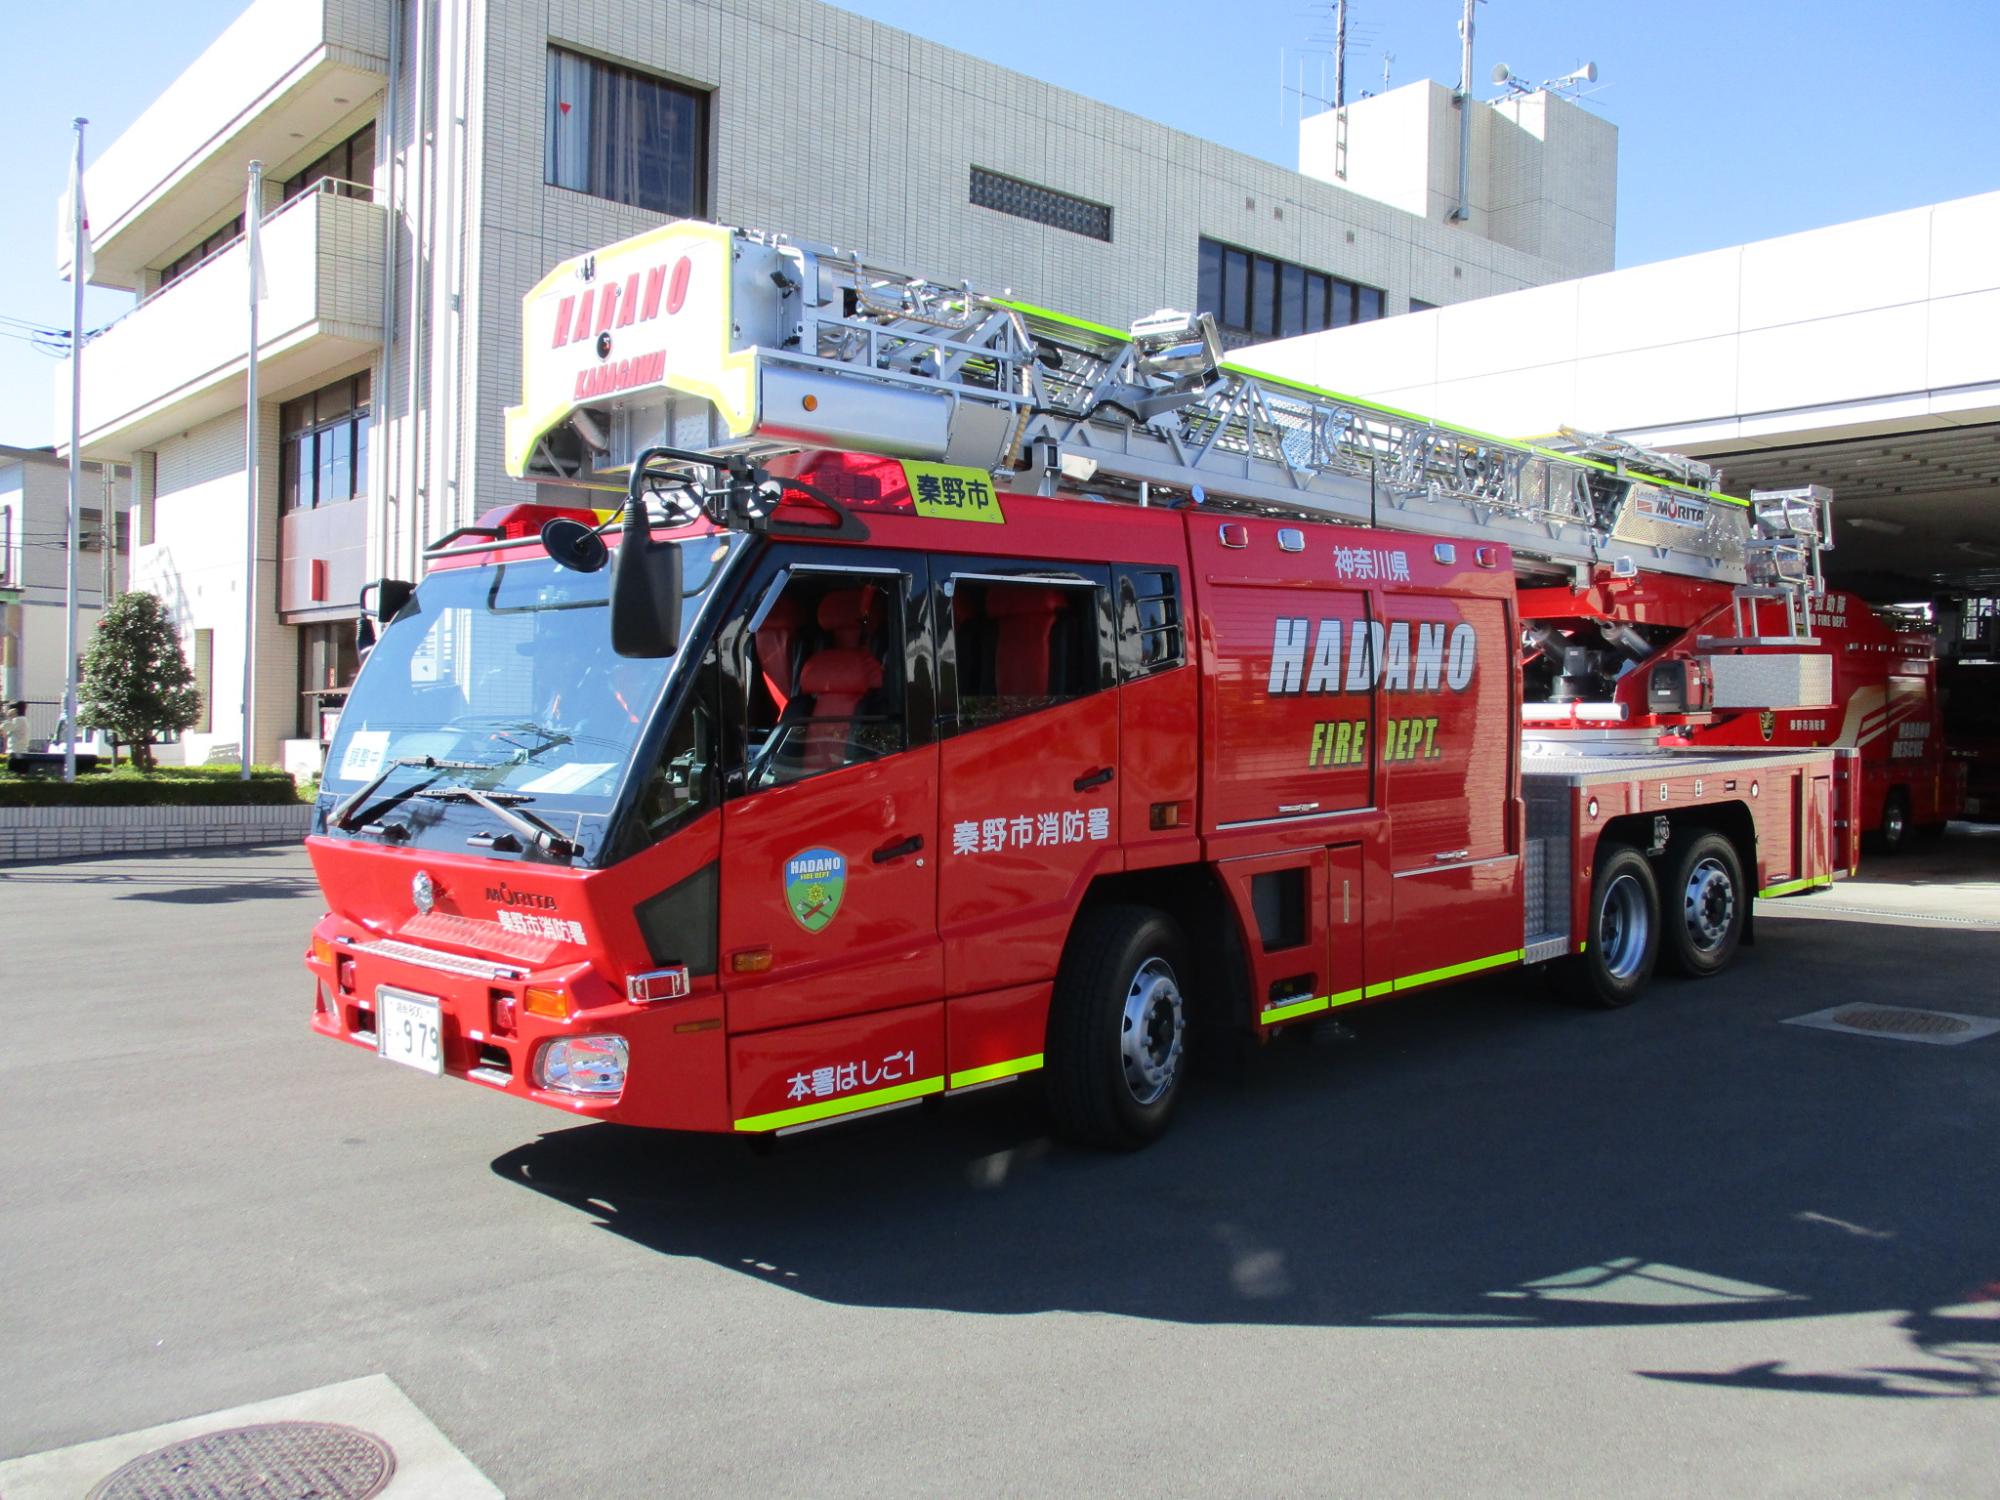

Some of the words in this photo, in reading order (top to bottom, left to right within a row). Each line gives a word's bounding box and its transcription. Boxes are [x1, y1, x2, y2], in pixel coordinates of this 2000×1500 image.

[552, 256, 691, 349] HADANO
[573, 350, 666, 401] KANAGAWA
[917, 473, 989, 510] 秦野市
[1656, 495, 1704, 522] MORITA
[1332, 545, 1411, 582] 神奈川県
[1267, 617, 1476, 696] HADANO
[1309, 721, 1366, 767] FIRE
[1384, 718, 1441, 762] DEPT.
[953, 807, 1110, 855] 秦野市消防署
[791, 857, 840, 874] HADANO
[485, 881, 557, 911] MORITA
[496, 909, 588, 945] 秦野市消防署
[786, 1049, 915, 1101] 本署はしご1
